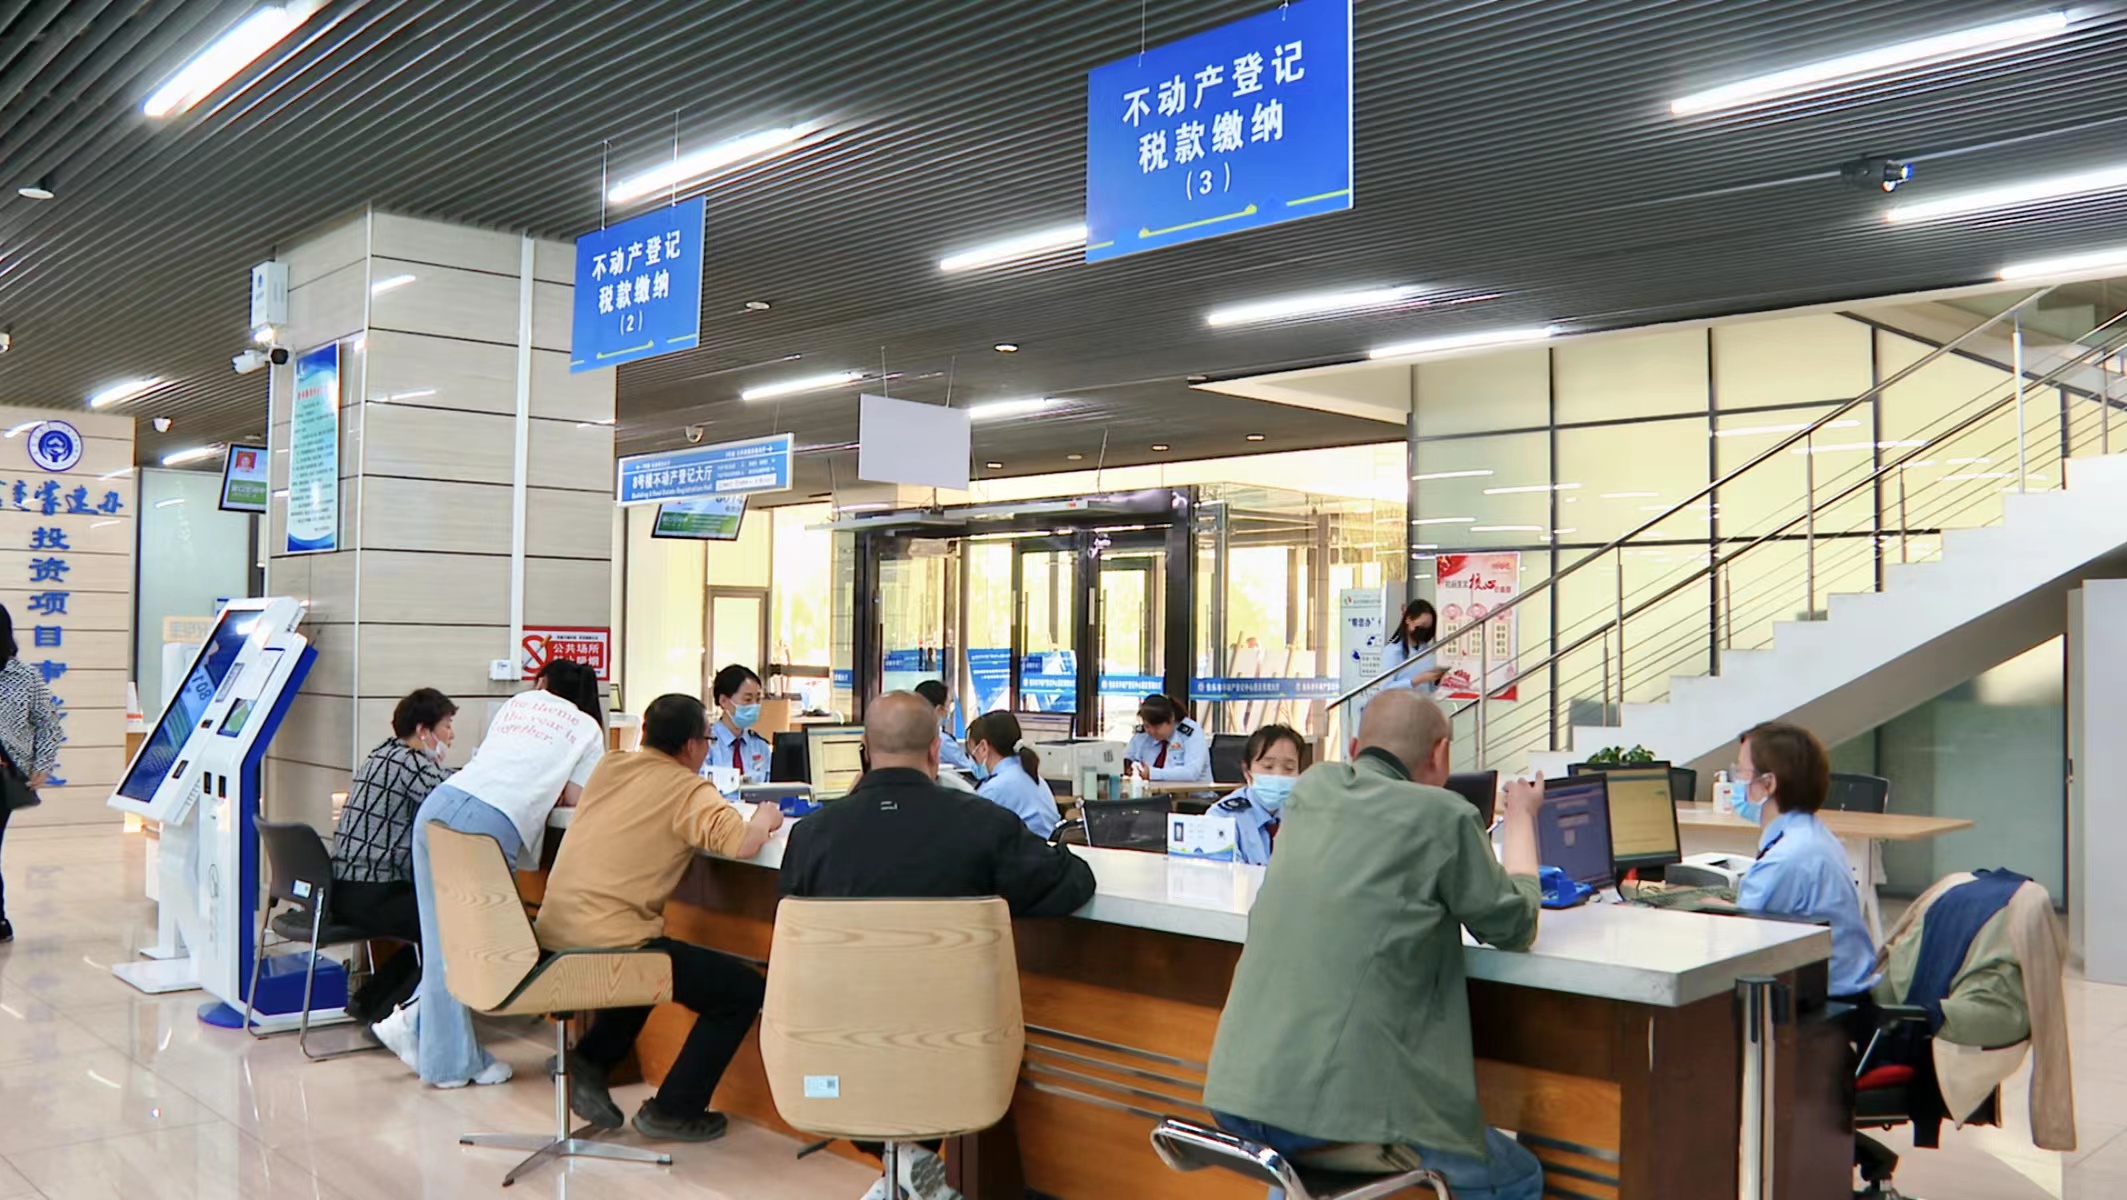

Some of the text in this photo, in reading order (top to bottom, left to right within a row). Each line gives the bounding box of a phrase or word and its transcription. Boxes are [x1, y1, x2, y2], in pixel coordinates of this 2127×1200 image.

[1122, 40, 1305, 128] 不动产登记
[1138, 98, 1284, 174] 税款缴纳
[591, 229, 680, 282] 不动产登记
[598, 268, 670, 315] 税款缴纳
[553, 643, 600, 654] 公共场所
